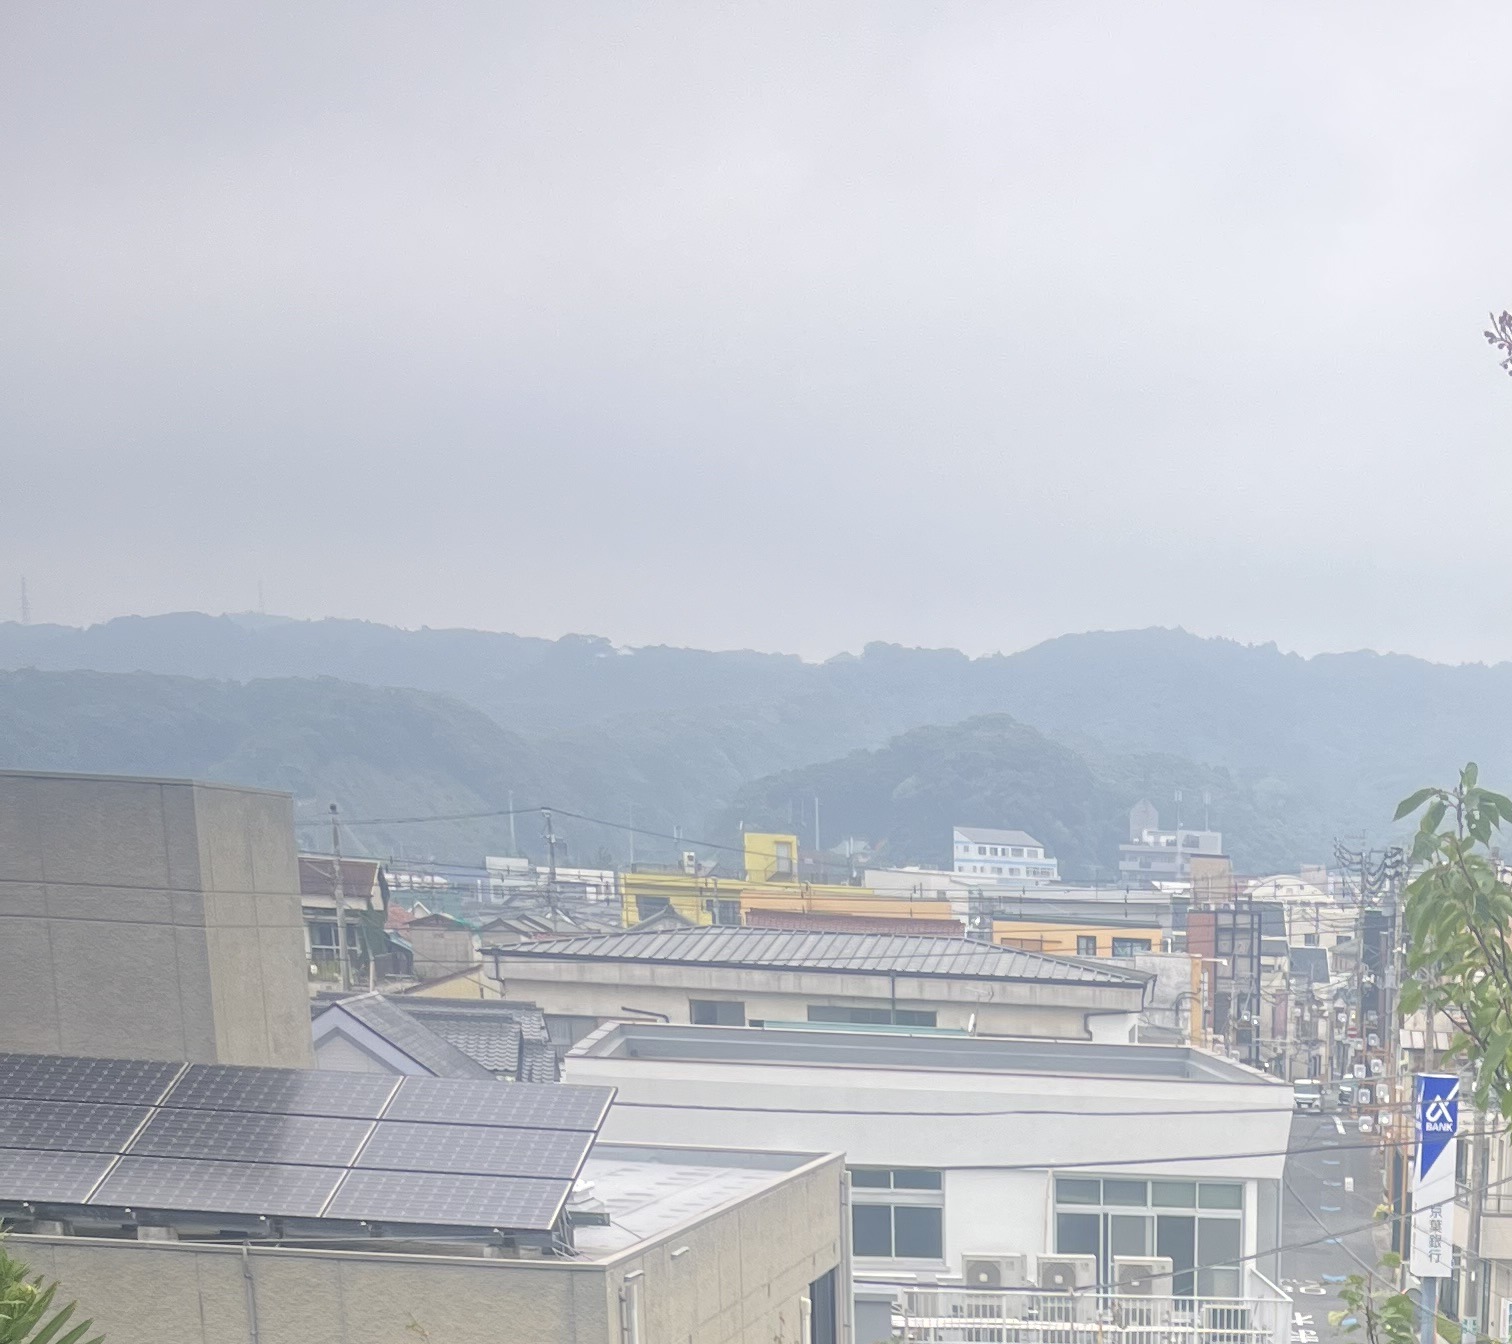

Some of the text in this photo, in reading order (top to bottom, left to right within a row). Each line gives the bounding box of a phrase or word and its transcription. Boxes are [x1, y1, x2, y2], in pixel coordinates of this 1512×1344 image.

[1426, 1122, 1453, 1131] BANK
[1429, 1204, 1442, 1263] 京葉銀行
